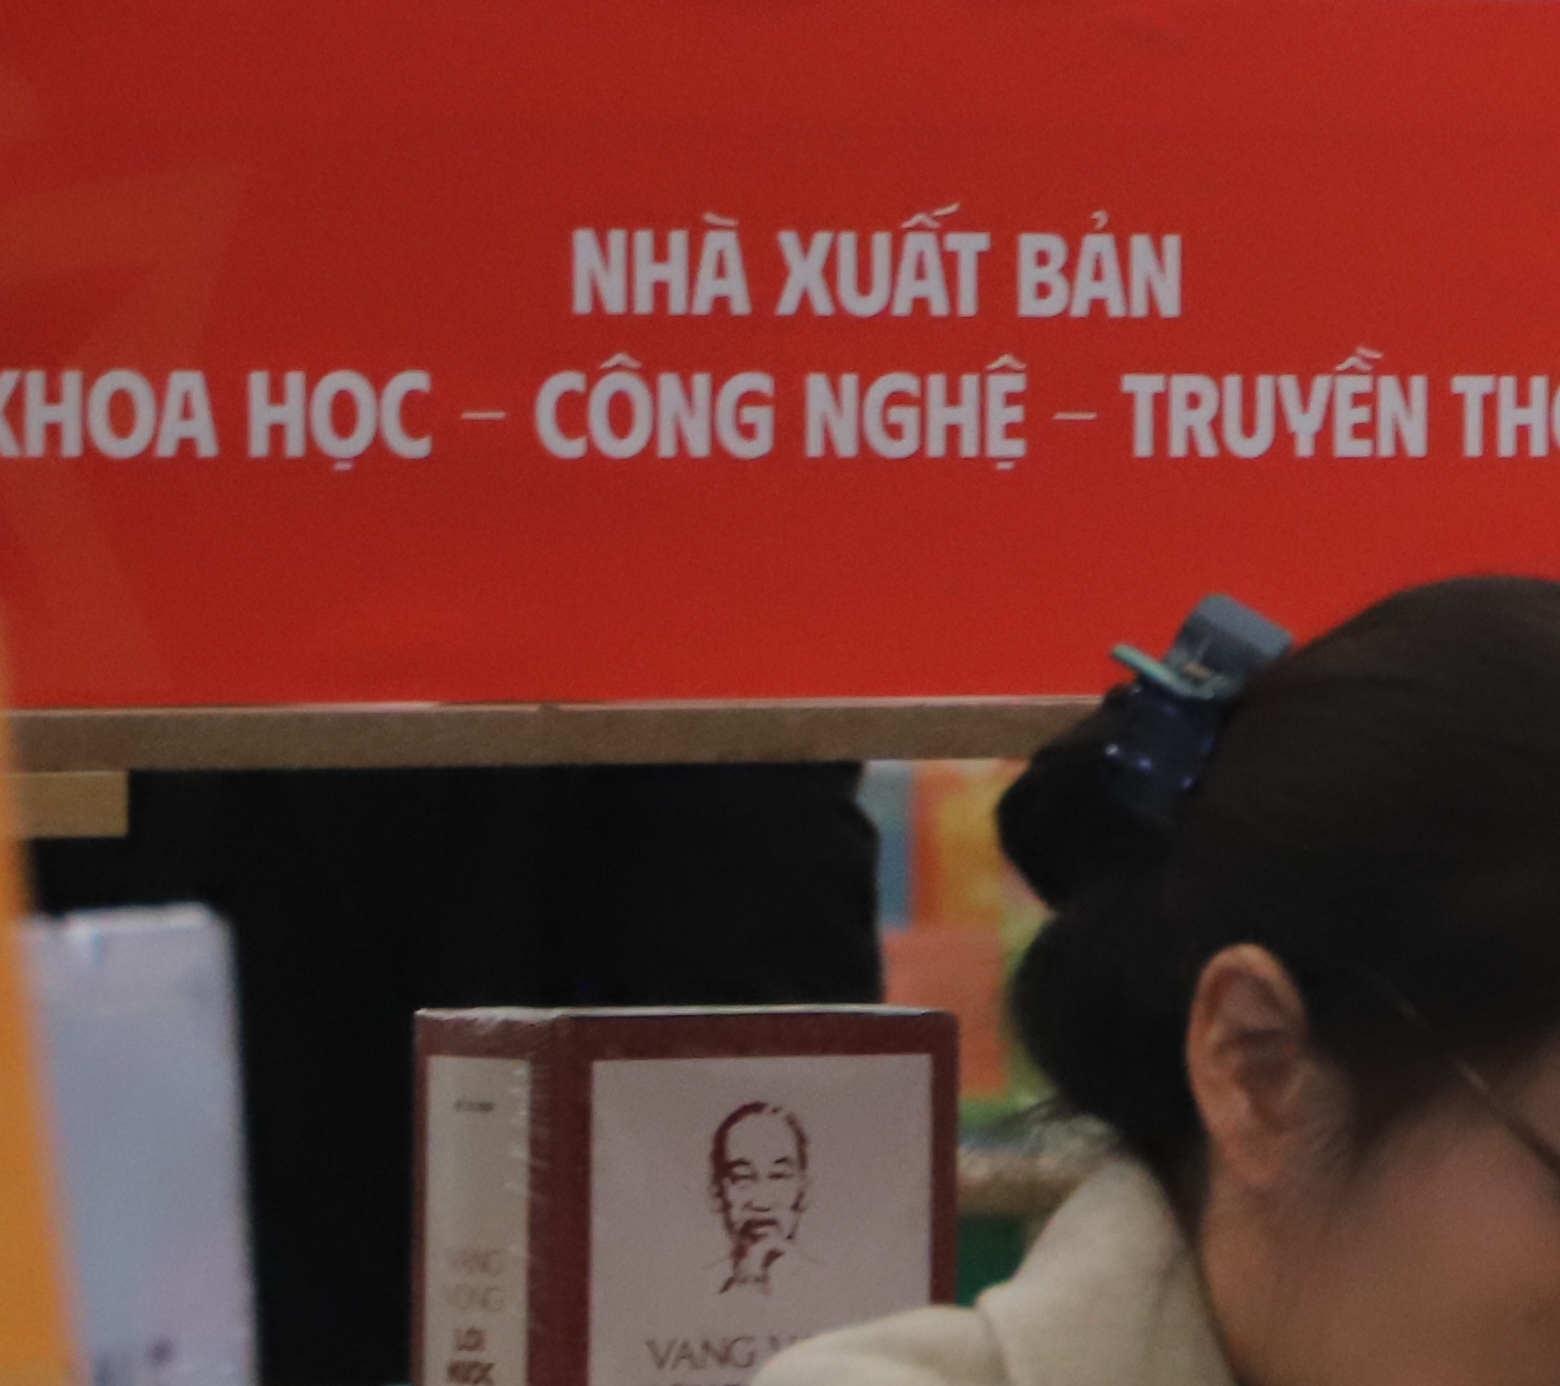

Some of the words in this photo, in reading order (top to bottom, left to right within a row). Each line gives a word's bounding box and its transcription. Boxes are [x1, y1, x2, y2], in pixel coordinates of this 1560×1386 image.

[570, 214, 748, 318] NHÀ
[776, 202, 991, 318] XUẤT
[1015, 210, 1184, 320] BẢN
[246, 368, 433, 472] HỌC
[533, 354, 775, 461] CÔNG
[803, 355, 1028, 471] NGHỆ
[1123, 345, 1430, 461] TRUYỀN
[645, 1336, 756, 1370] VANG
